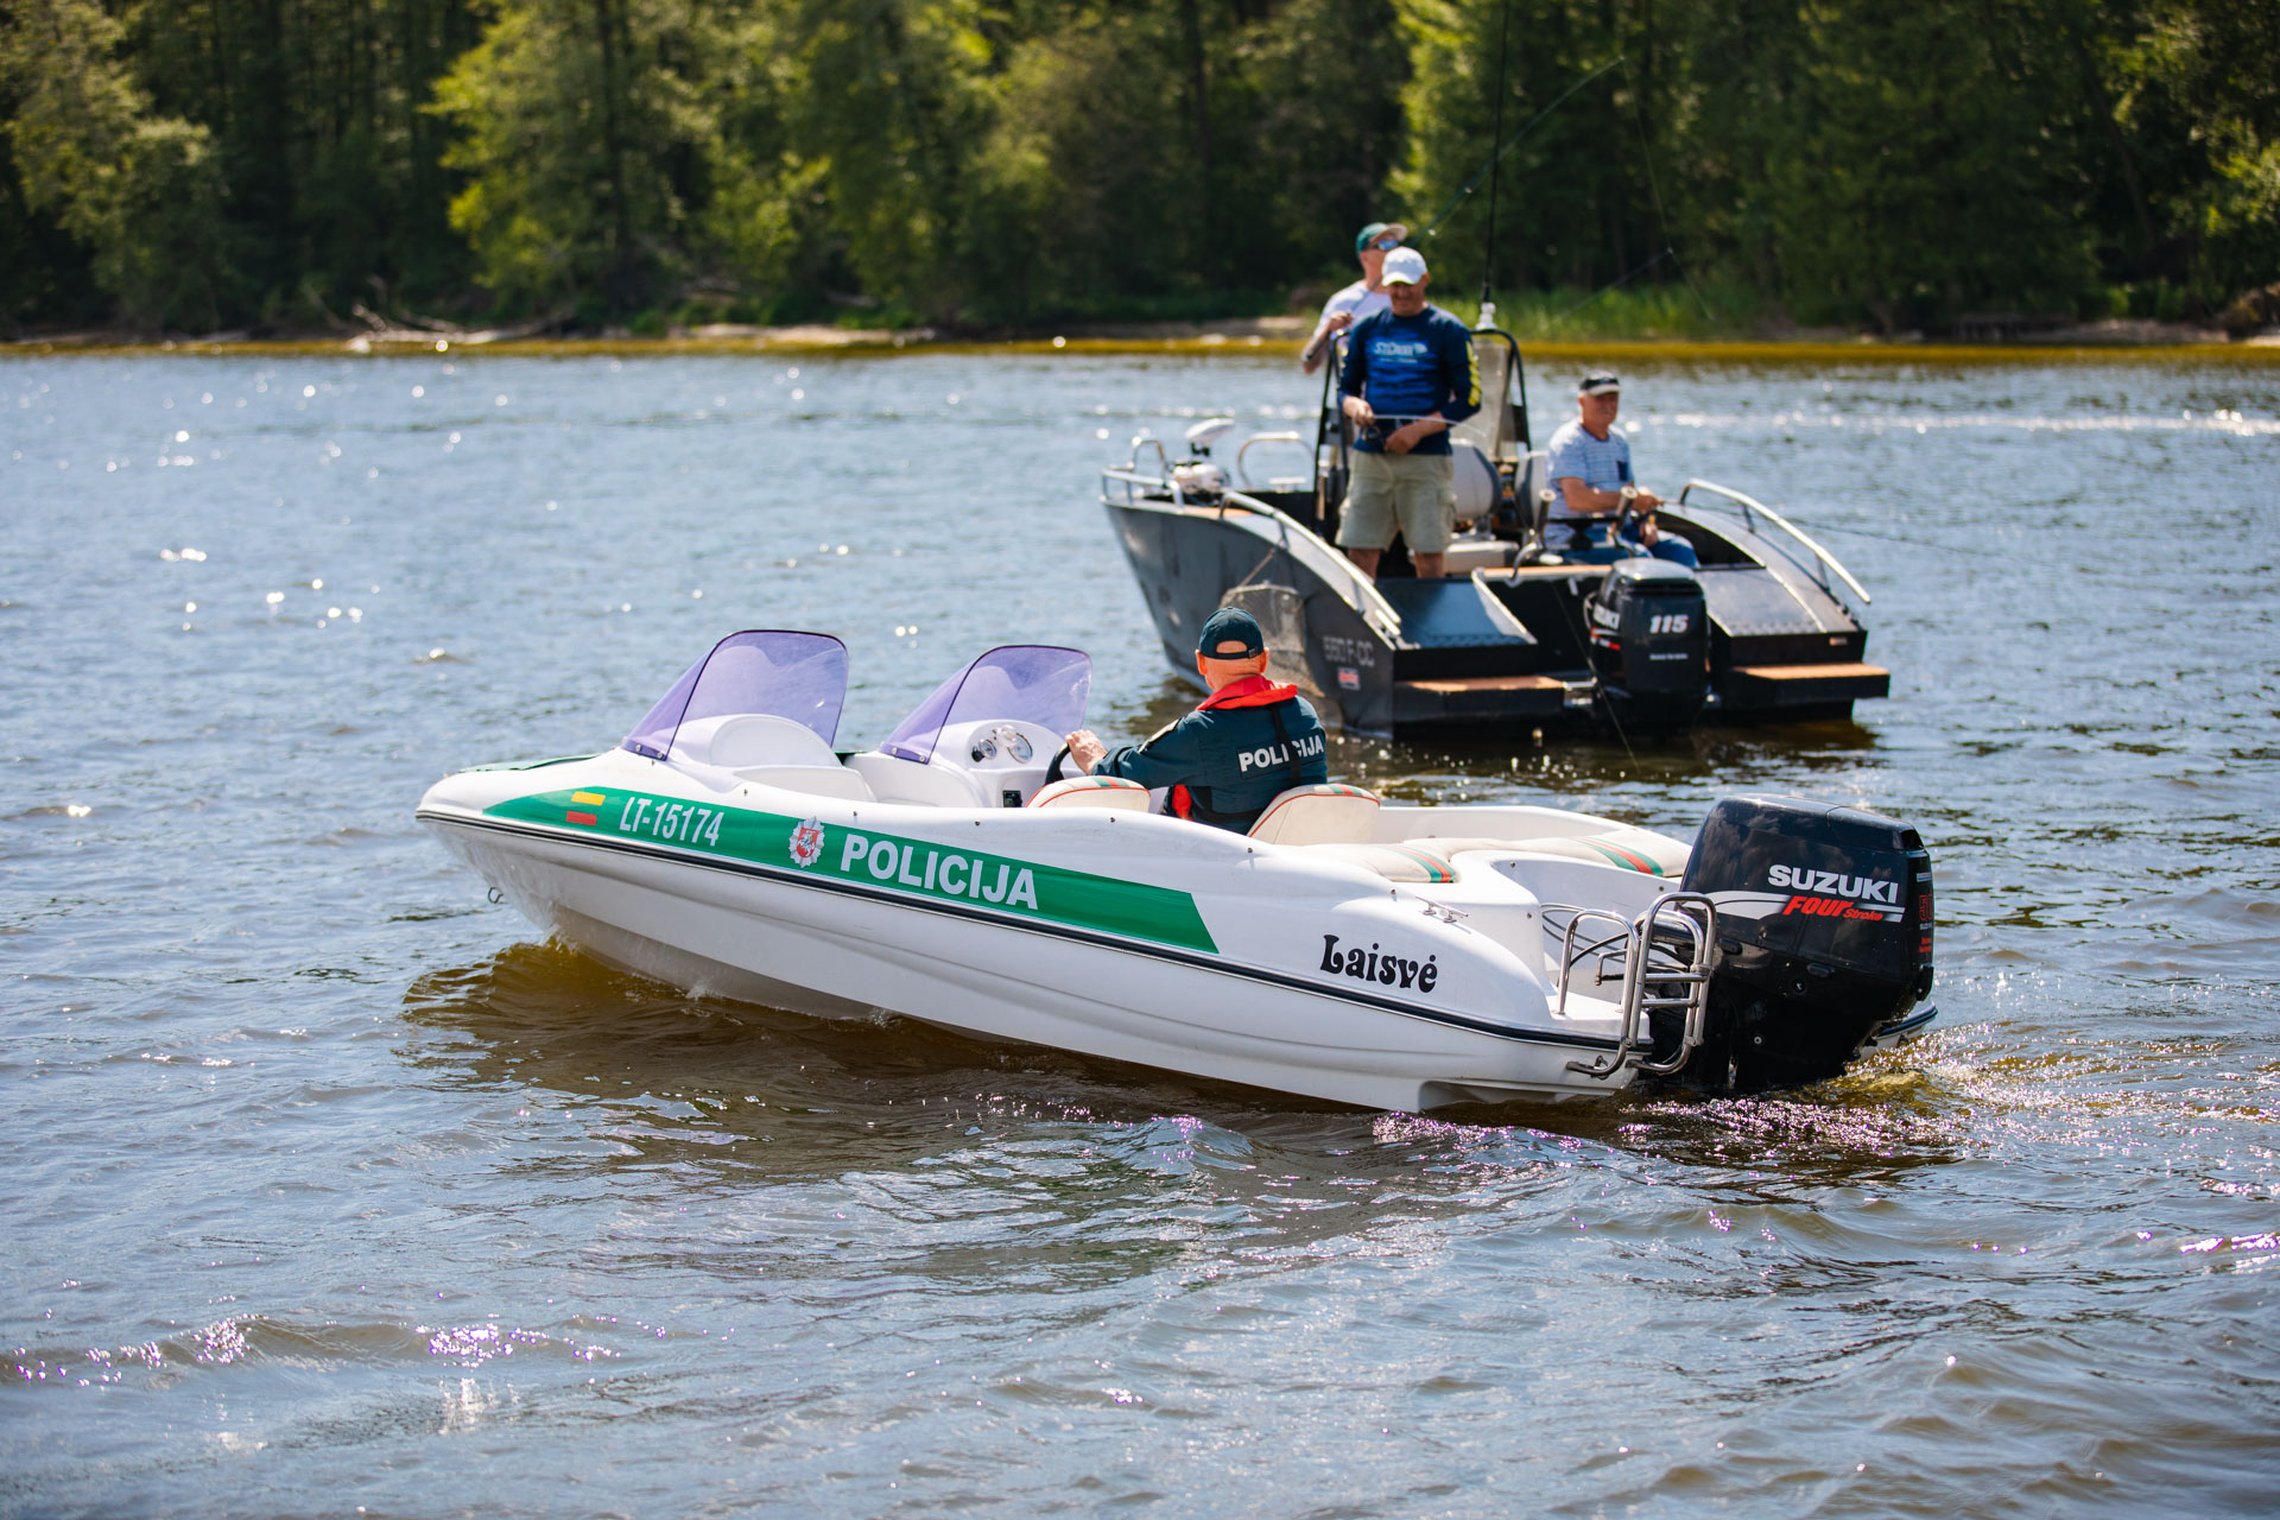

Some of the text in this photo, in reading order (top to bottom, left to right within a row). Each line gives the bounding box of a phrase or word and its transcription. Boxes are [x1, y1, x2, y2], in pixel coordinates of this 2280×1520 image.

[1649, 614, 1689, 634] 115
[619, 796, 725, 847] LT-15174
[840, 833, 1039, 910] POLICIJA
[1767, 864, 1899, 904] SUZUKI
[1320, 934, 1438, 993] Laisvė
